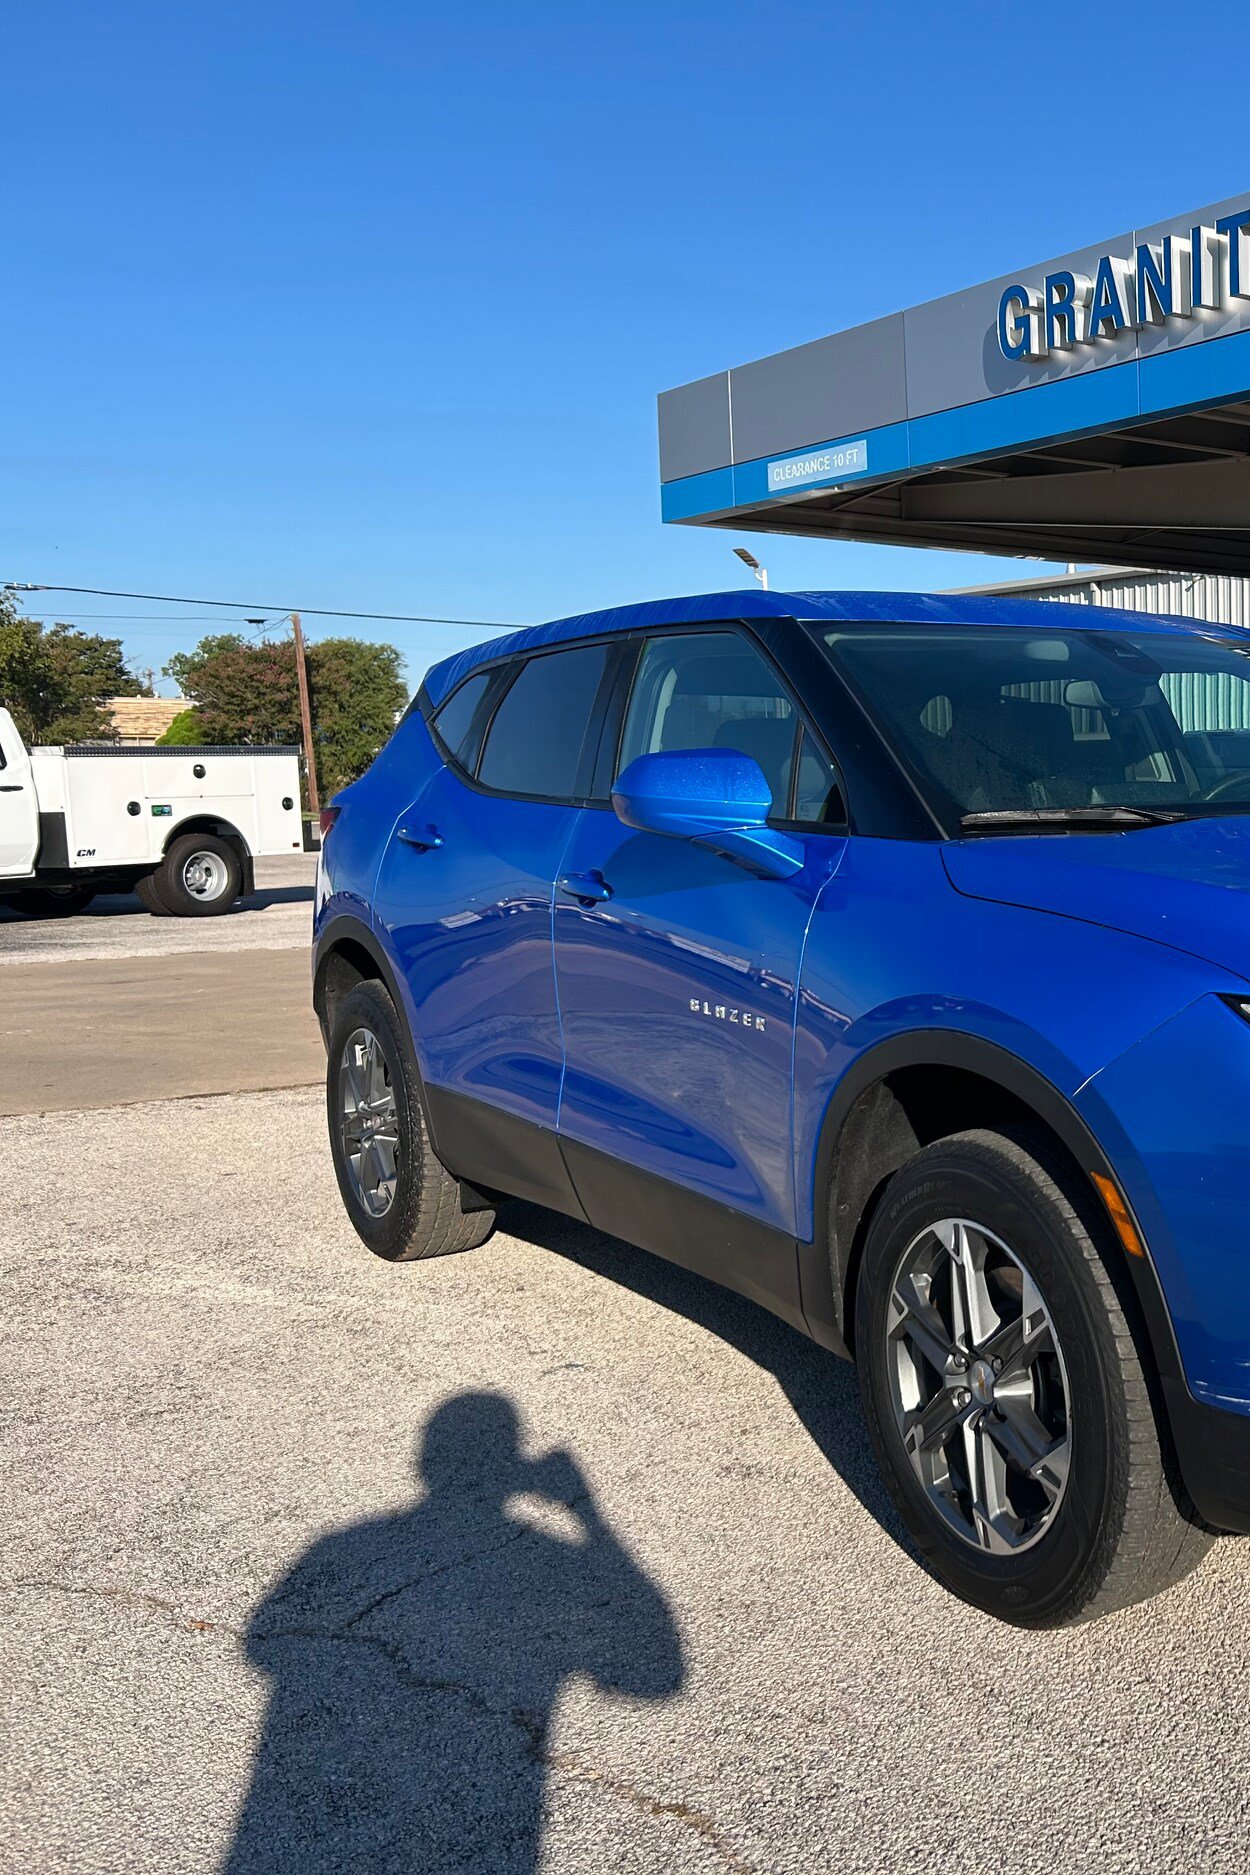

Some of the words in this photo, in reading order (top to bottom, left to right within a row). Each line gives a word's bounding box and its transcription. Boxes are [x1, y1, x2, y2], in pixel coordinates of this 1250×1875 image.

[773, 455, 831, 482] CLEARANCE
[833, 453, 845, 468] 10
[846, 449, 859, 466] FT
[76, 848, 97, 857] CM
[689, 998, 766, 1032] BLAZER
